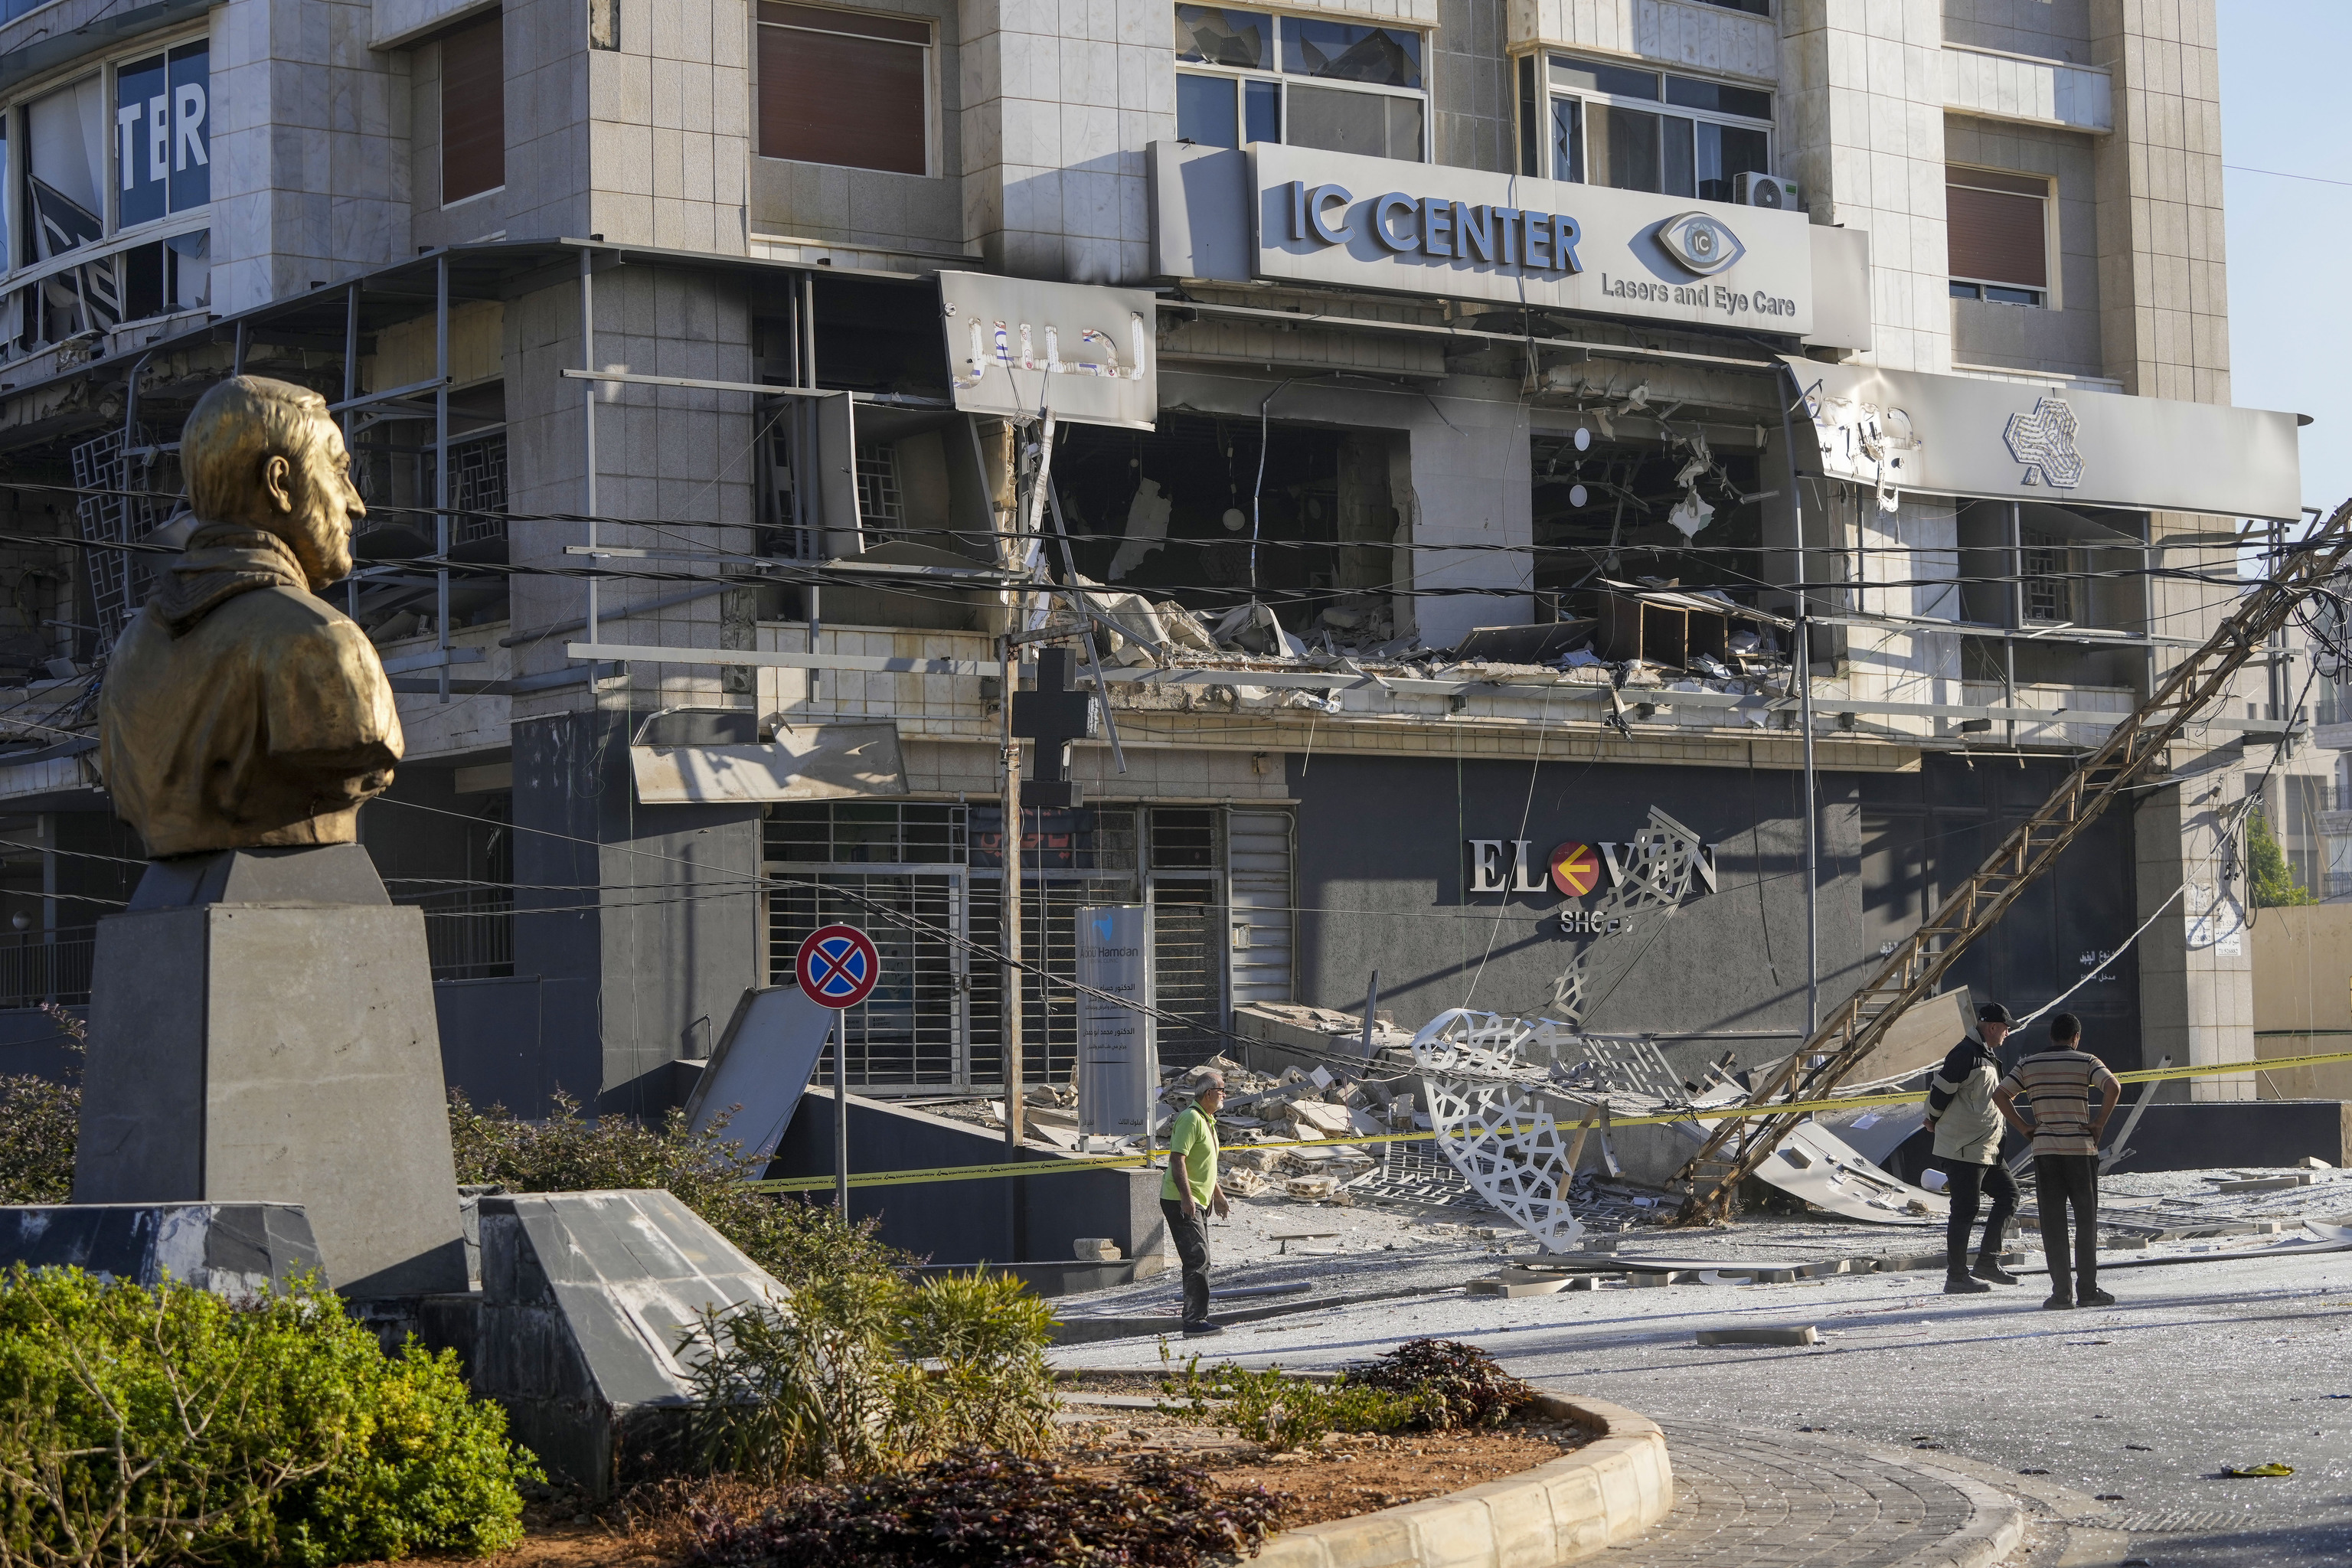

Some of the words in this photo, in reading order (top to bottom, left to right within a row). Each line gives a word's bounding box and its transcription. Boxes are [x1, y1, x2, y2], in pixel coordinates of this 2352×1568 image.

[1289, 179, 1356, 245] IC
[1375, 191, 1585, 273] CENTER
[1694, 236, 1710, 251] IC
[1601, 273, 1669, 304] Lasers
[1673, 281, 1710, 309] and
[1713, 286, 1749, 317] Eye
[1752, 291, 1796, 318] Care
[1098, 946, 1138, 957] Hamdan
[2079, 950, 2096, 965] الوقوف
[2099, 973, 2116, 982] مدخل
[1115, 983, 1135, 992] الدكتور
[1115, 1027, 1135, 1036] الدكتور
[1130, 1119, 1144, 1127] البلوك
